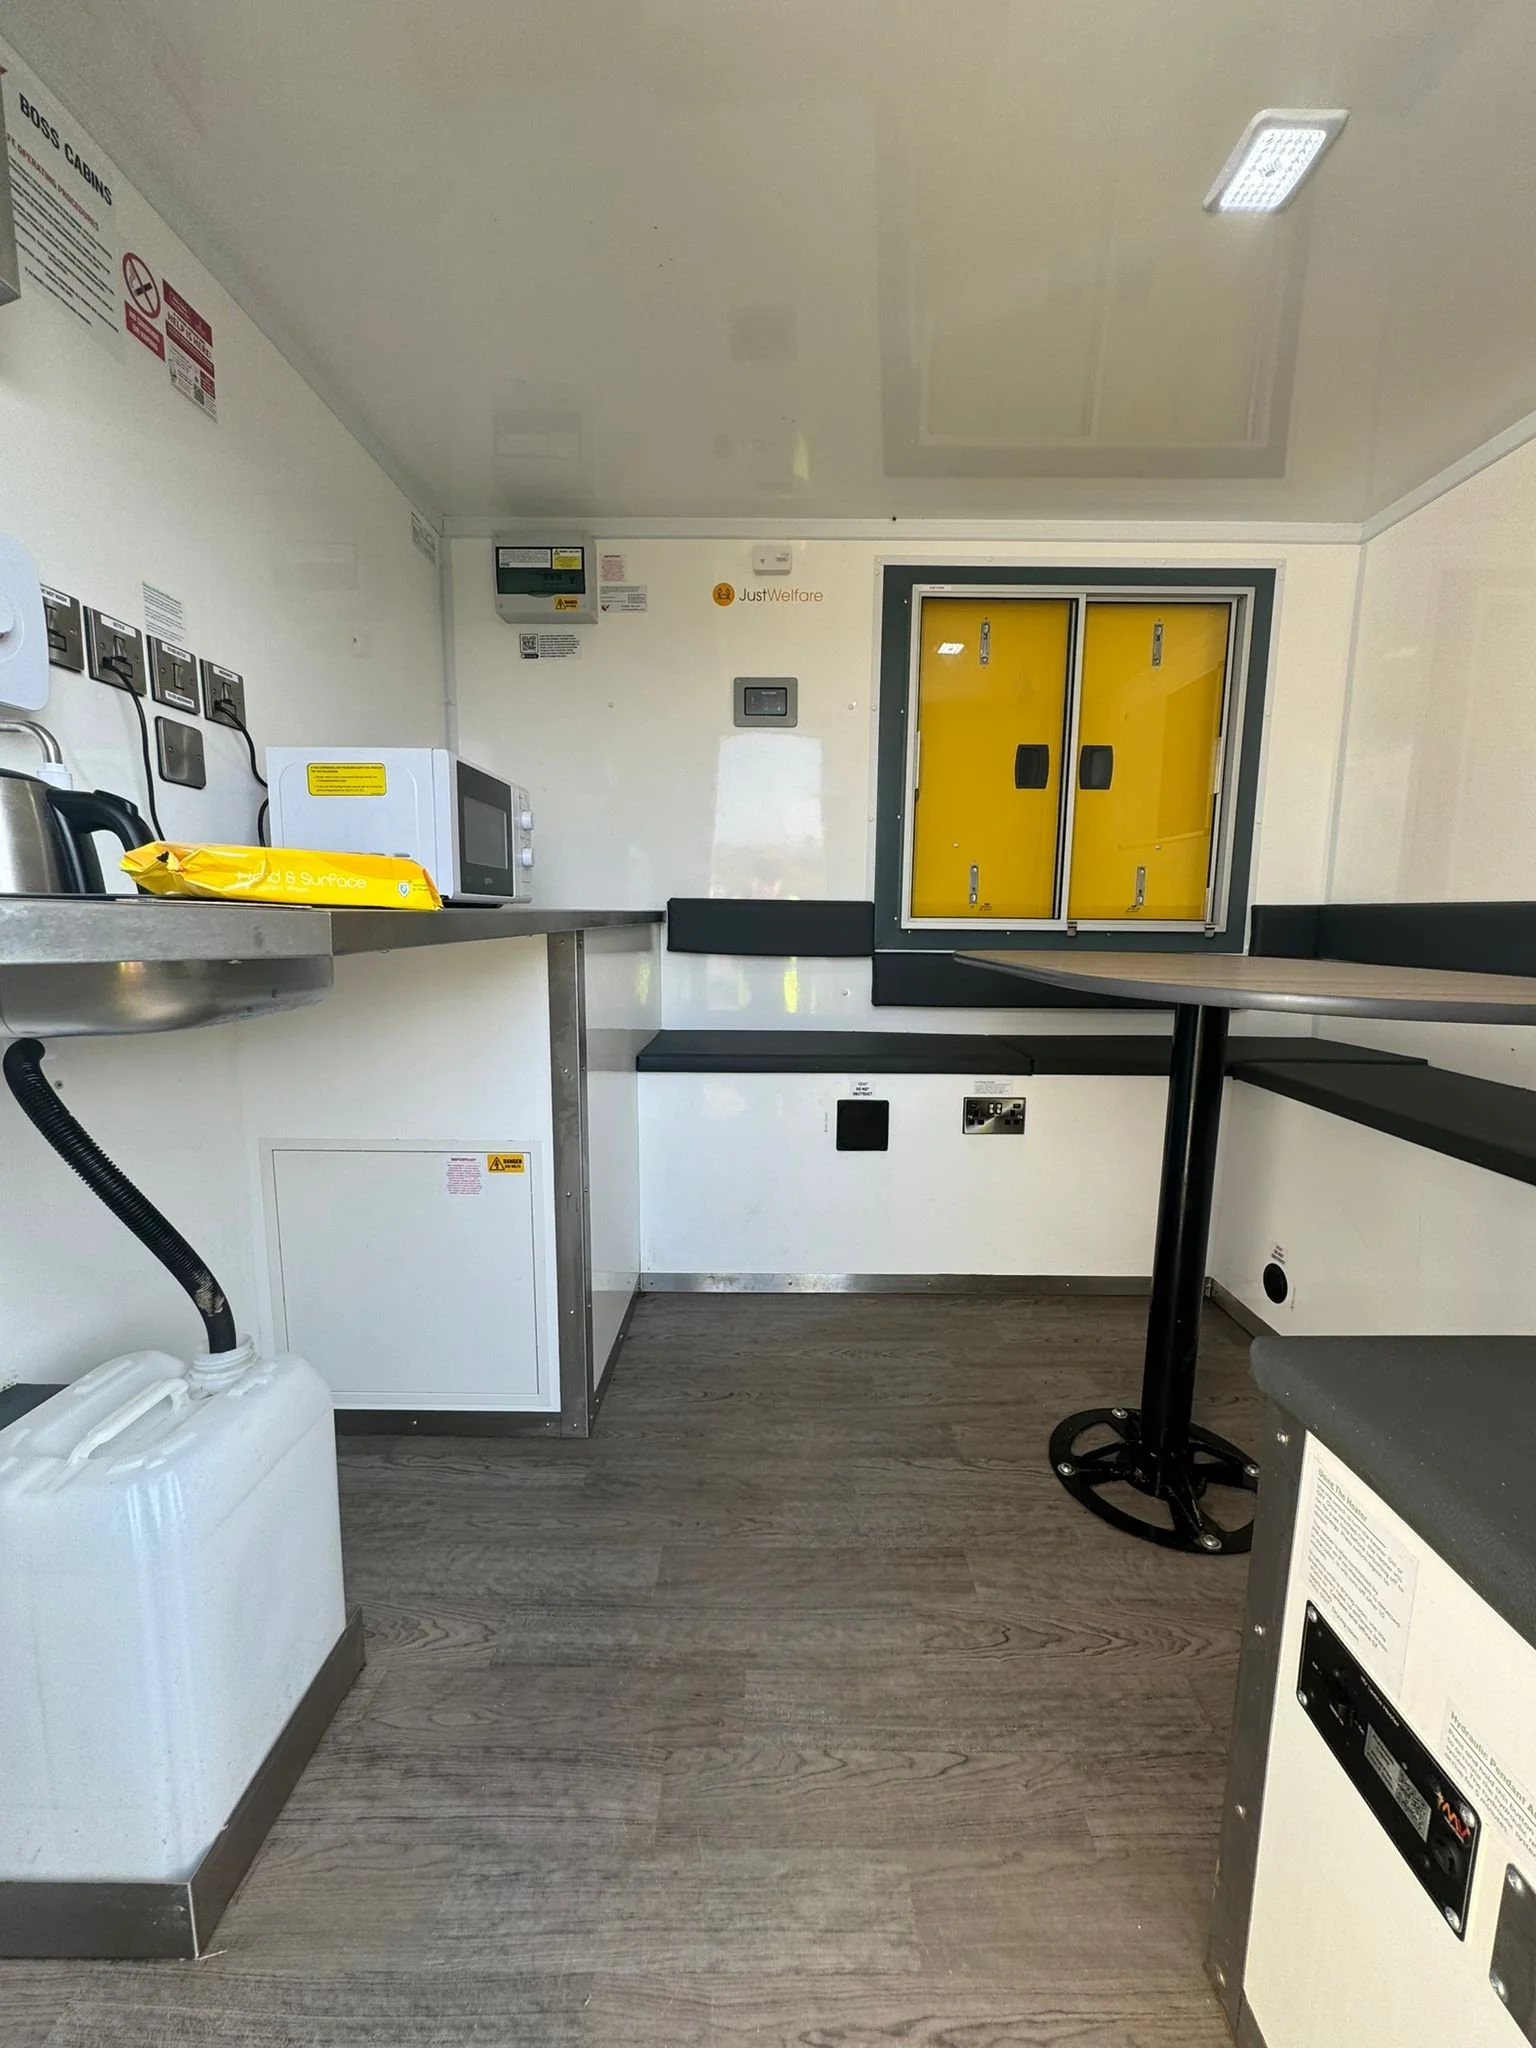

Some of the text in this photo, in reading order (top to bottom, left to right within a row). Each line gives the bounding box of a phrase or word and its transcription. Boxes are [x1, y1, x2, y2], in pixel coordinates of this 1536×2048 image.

[19, 92, 113, 206] BOSS CABINS
[168, 310, 185, 333] HELP
[739, 588, 824, 602] JustWelfare
[300, 871, 368, 889] Surface
[1318, 1467, 1368, 1522] Using The Heater
[1450, 1710, 1489, 1761] Hydraulic
[1489, 1757, 1526, 1804] Pendant
[1464, 1747, 1478, 1768] and
[1478, 1764, 1494, 1788] hold
[1509, 1801, 1534, 1837] button
